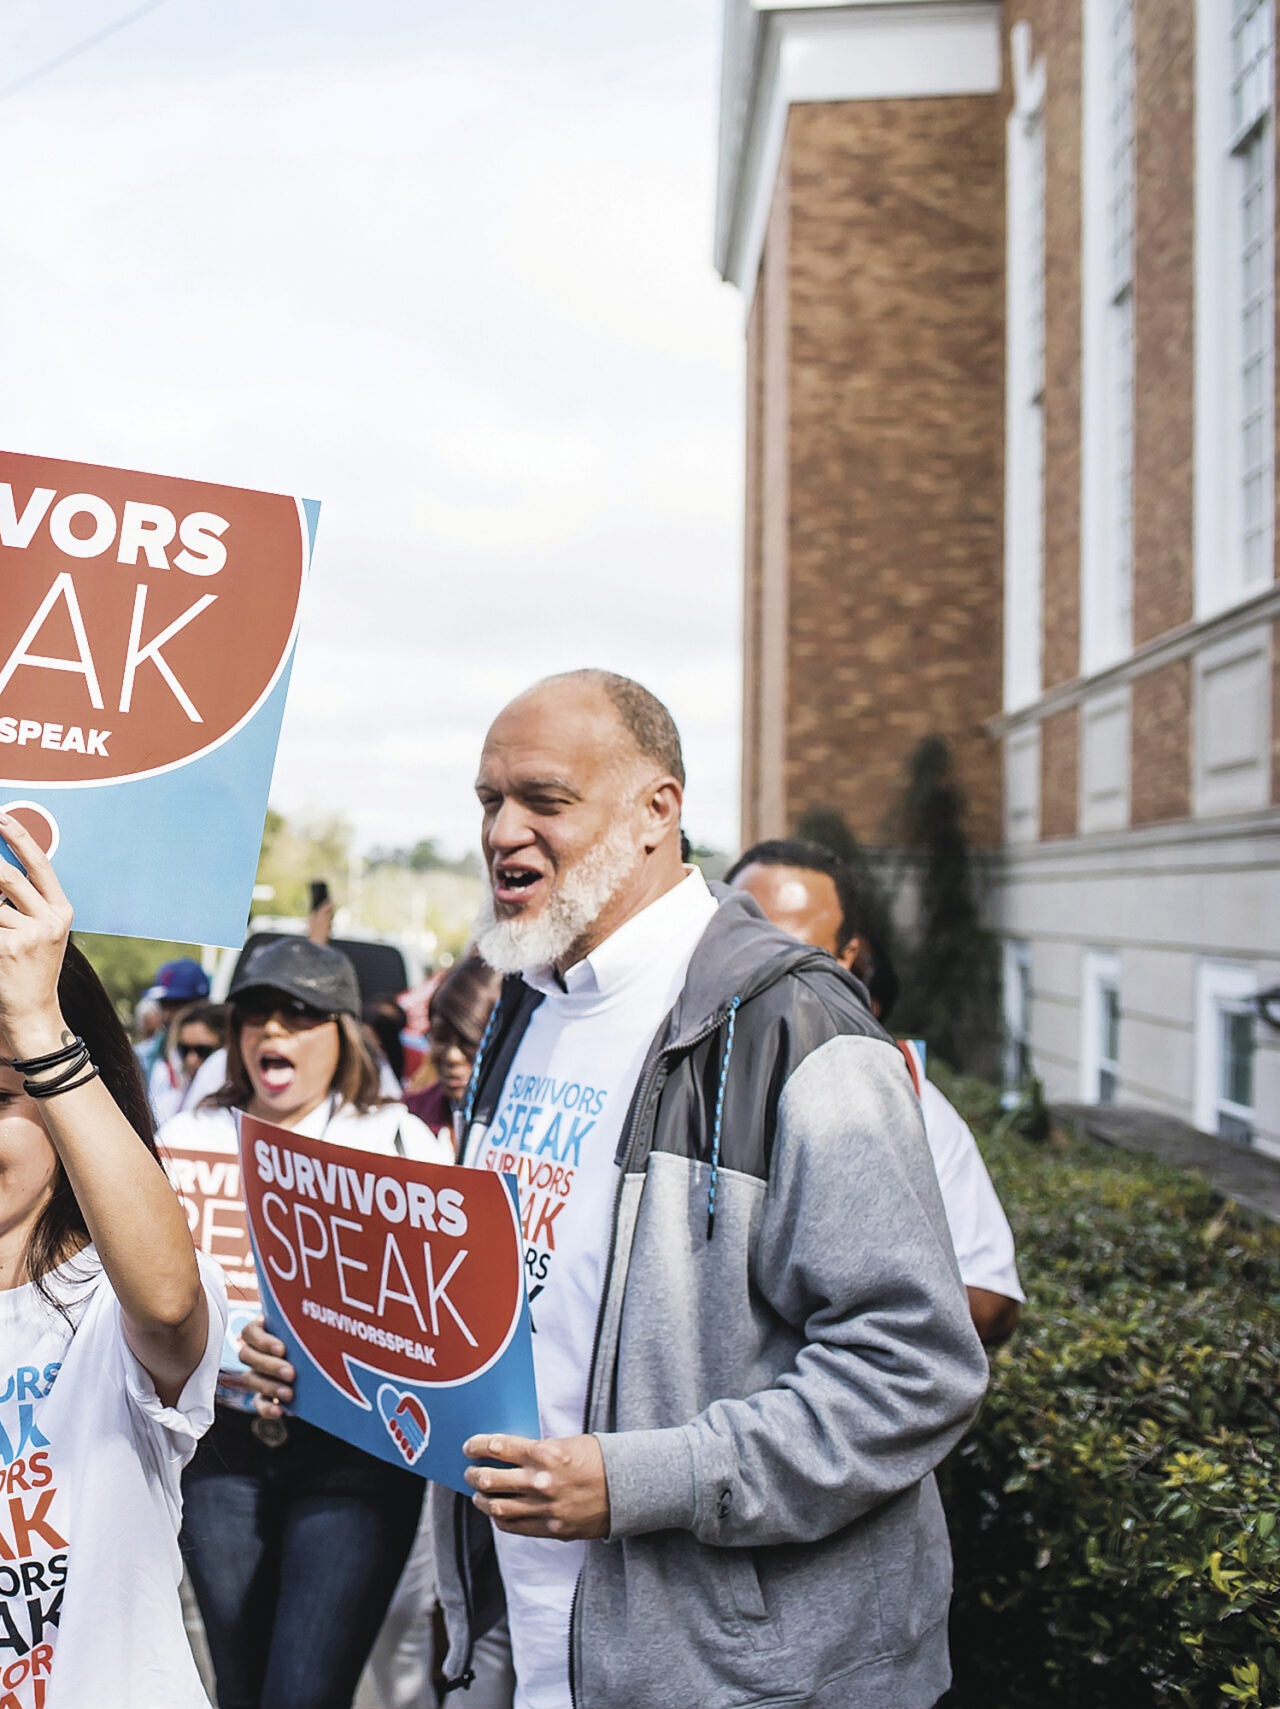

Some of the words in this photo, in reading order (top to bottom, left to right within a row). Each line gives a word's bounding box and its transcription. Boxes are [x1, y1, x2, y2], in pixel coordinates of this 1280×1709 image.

[254, 1139, 468, 1237] SURVIVORS
[262, 1191, 479, 1347] SPEAK
[301, 1298, 437, 1366] #SURVIVORSSPEAK
